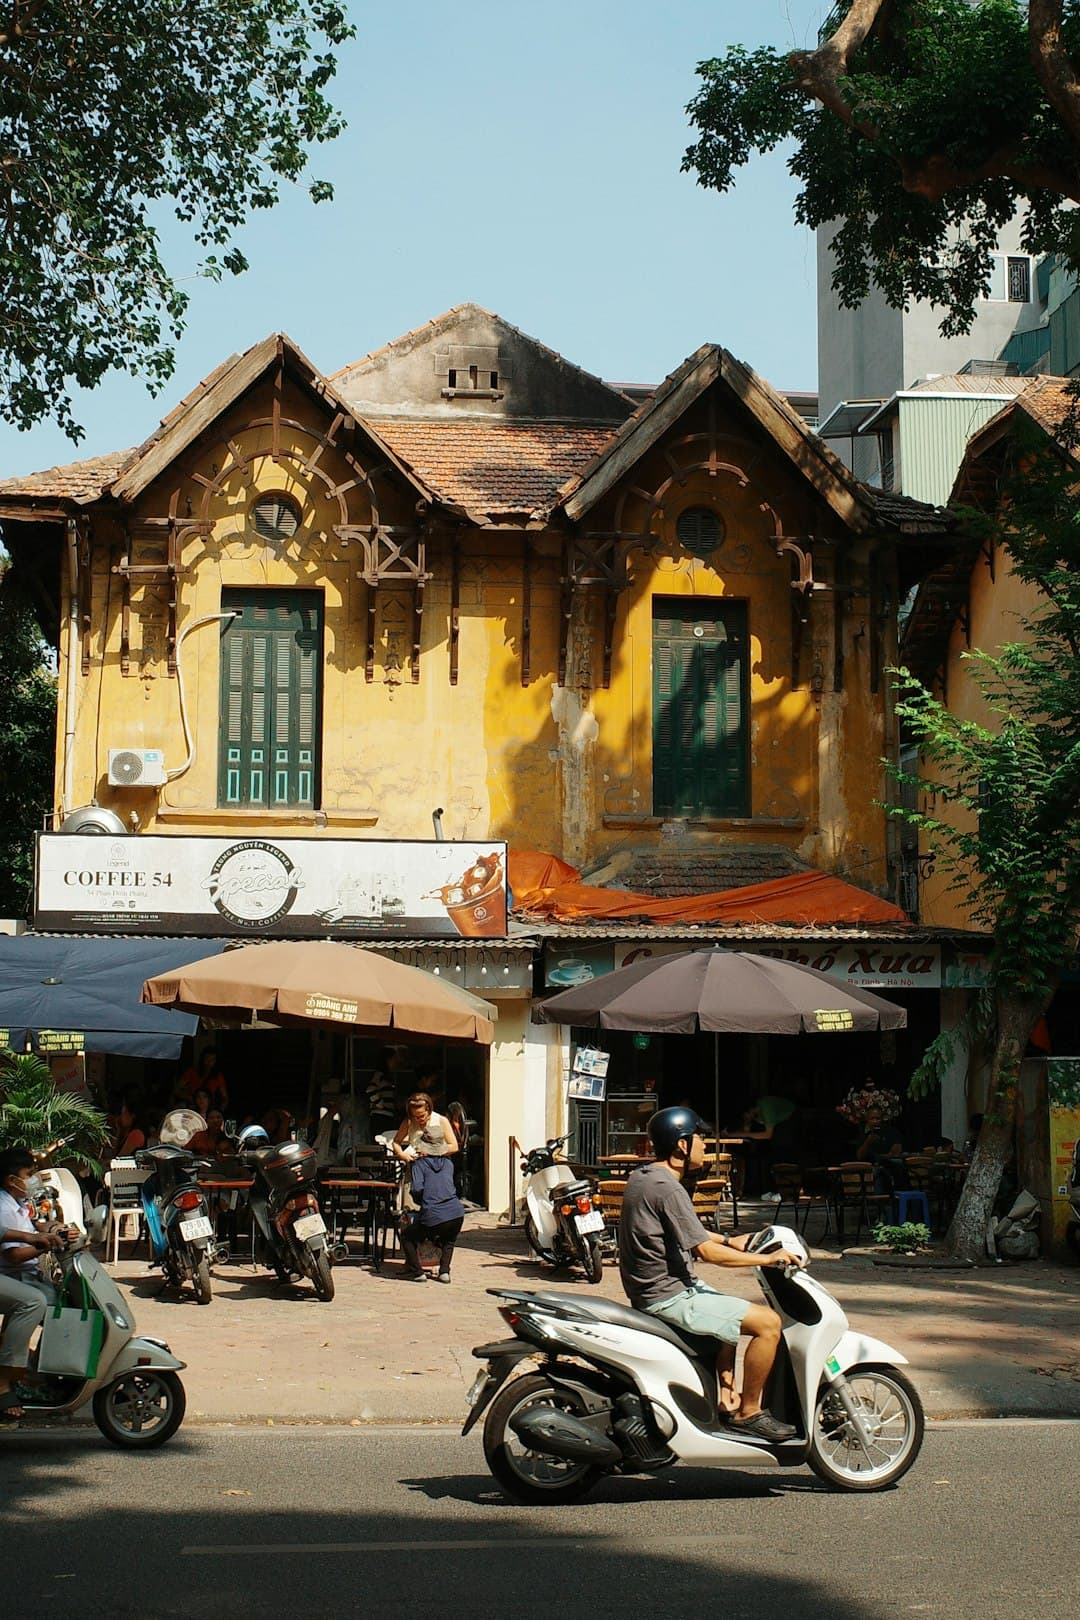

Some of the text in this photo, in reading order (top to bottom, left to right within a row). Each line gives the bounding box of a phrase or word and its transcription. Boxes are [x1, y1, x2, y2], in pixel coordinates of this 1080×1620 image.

[214, 850, 232, 872] TRUNG
[233, 841, 264, 852] NGUYÊN
[266, 846, 290, 867] LEGEND
[63, 870, 173, 887] COFFEE 54
[221, 908, 234, 921] THE
[847, 948, 935, 974] Xưa
[341, 1003, 358, 1014] ANH
